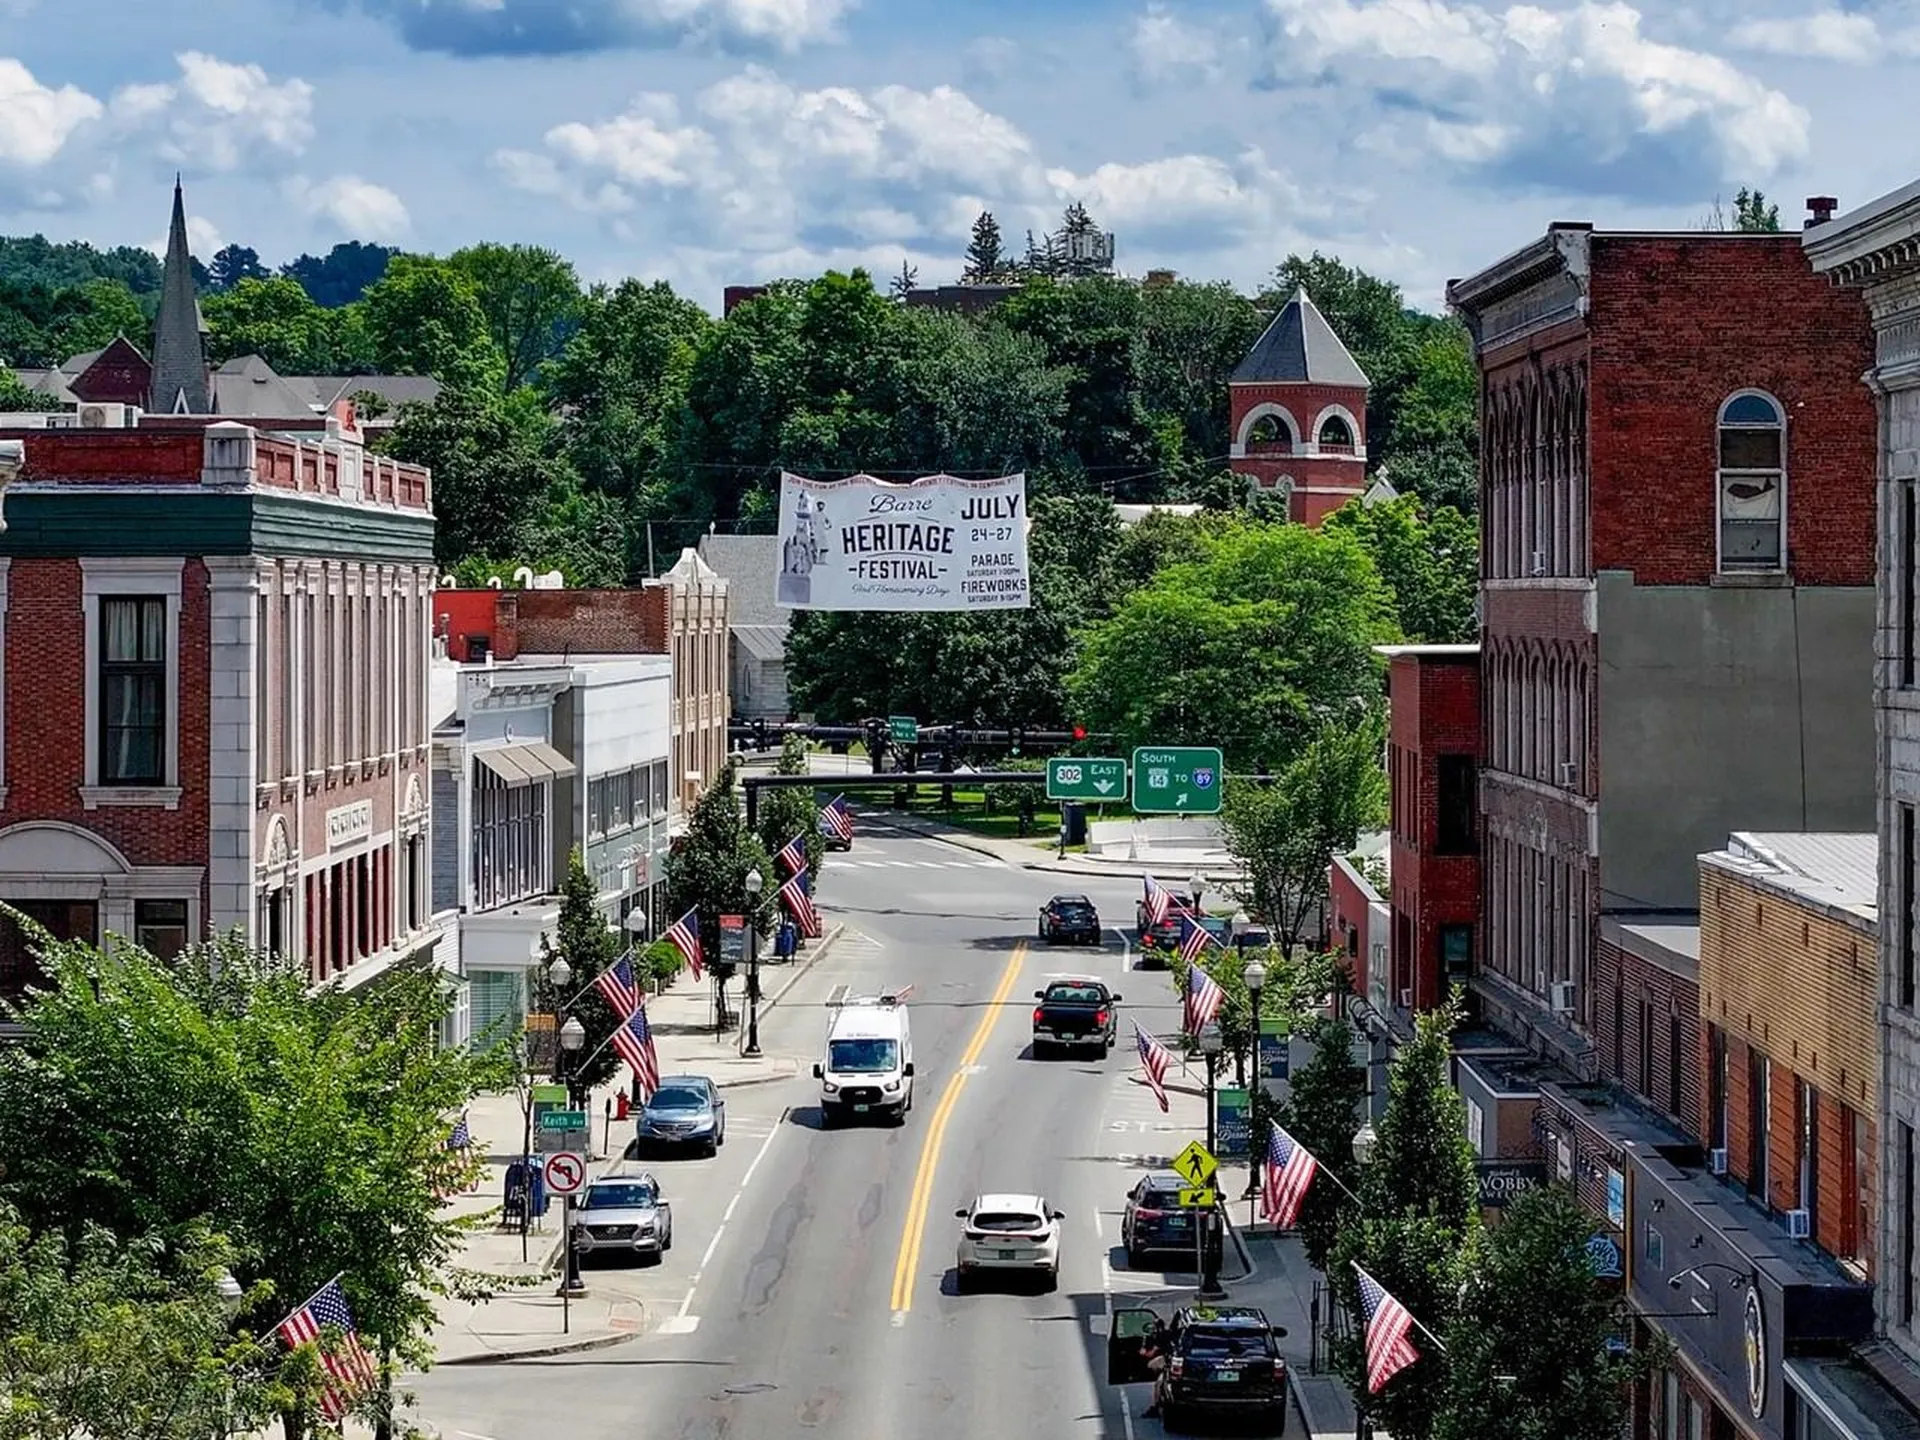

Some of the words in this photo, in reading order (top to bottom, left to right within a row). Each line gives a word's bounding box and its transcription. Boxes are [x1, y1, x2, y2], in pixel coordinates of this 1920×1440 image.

[869, 493, 934, 514] Barre
[961, 494, 1020, 520] JULY
[841, 523, 955, 555] HERITAGE
[971, 527, 1013, 542] 24-27
[971, 553, 1014, 567] PARADE
[966, 567, 997, 577] SATURDAY
[961, 578, 1027, 594] FIREWORKS
[967, 594, 998, 603] SATURDAY
[1059, 768, 1081, 781] 302
[1152, 775, 1165, 786] 14
[1174, 773, 1189, 784] TO
[1196, 773, 1212, 785] 89
[544, 1115, 568, 1127] Keith
